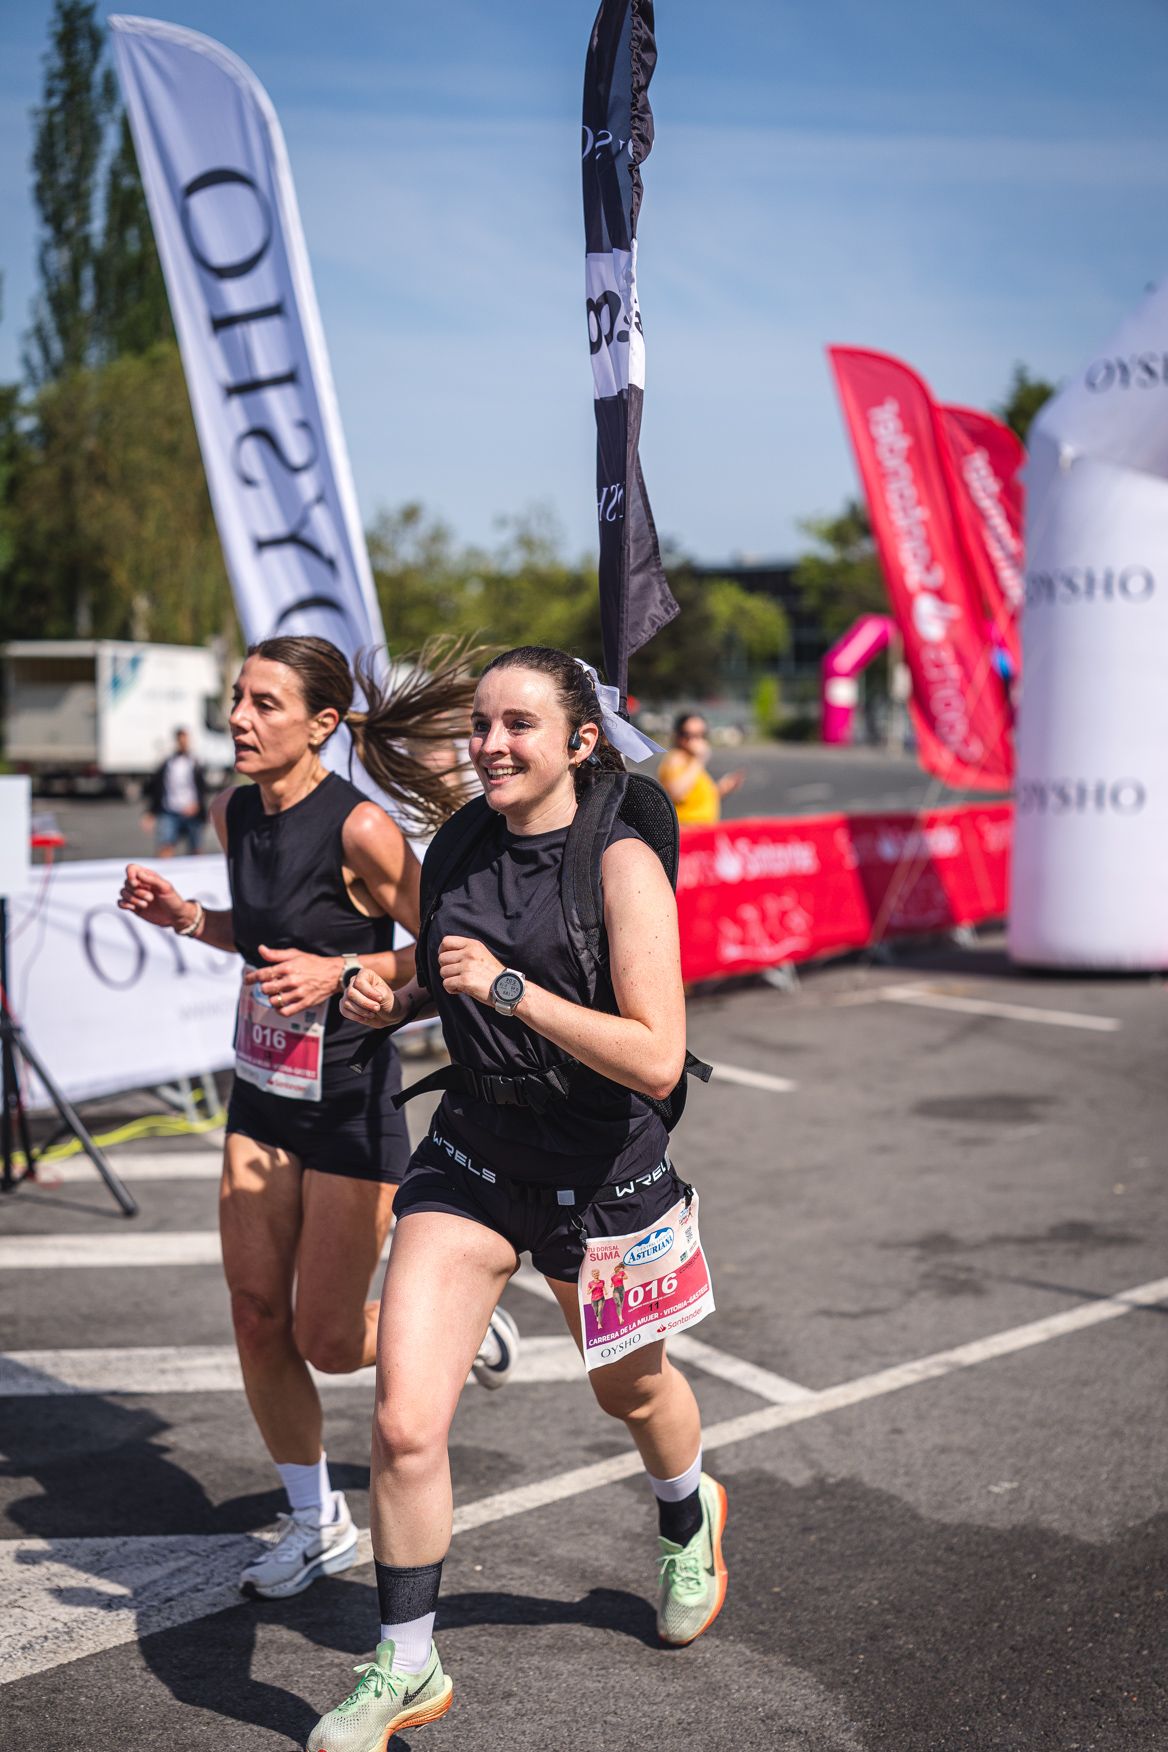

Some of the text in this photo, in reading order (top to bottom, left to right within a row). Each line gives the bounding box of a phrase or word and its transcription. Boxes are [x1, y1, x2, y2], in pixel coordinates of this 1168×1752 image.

[252, 1024, 287, 1050] 016
[432, 1130, 496, 1184] WRELS
[590, 1250, 620, 1262] SUMA
[628, 1272, 678, 1308] 016
[648, 1301, 660, 1312] 11
[667, 1306, 703, 1330] Santander
[588, 1330, 620, 1346] CARRERA
[619, 1326, 629, 1336] DE
[629, 1321, 638, 1331] LA
[637, 1313, 659, 1327] MUJER
[600, 1333, 641, 1359] OYSHO
